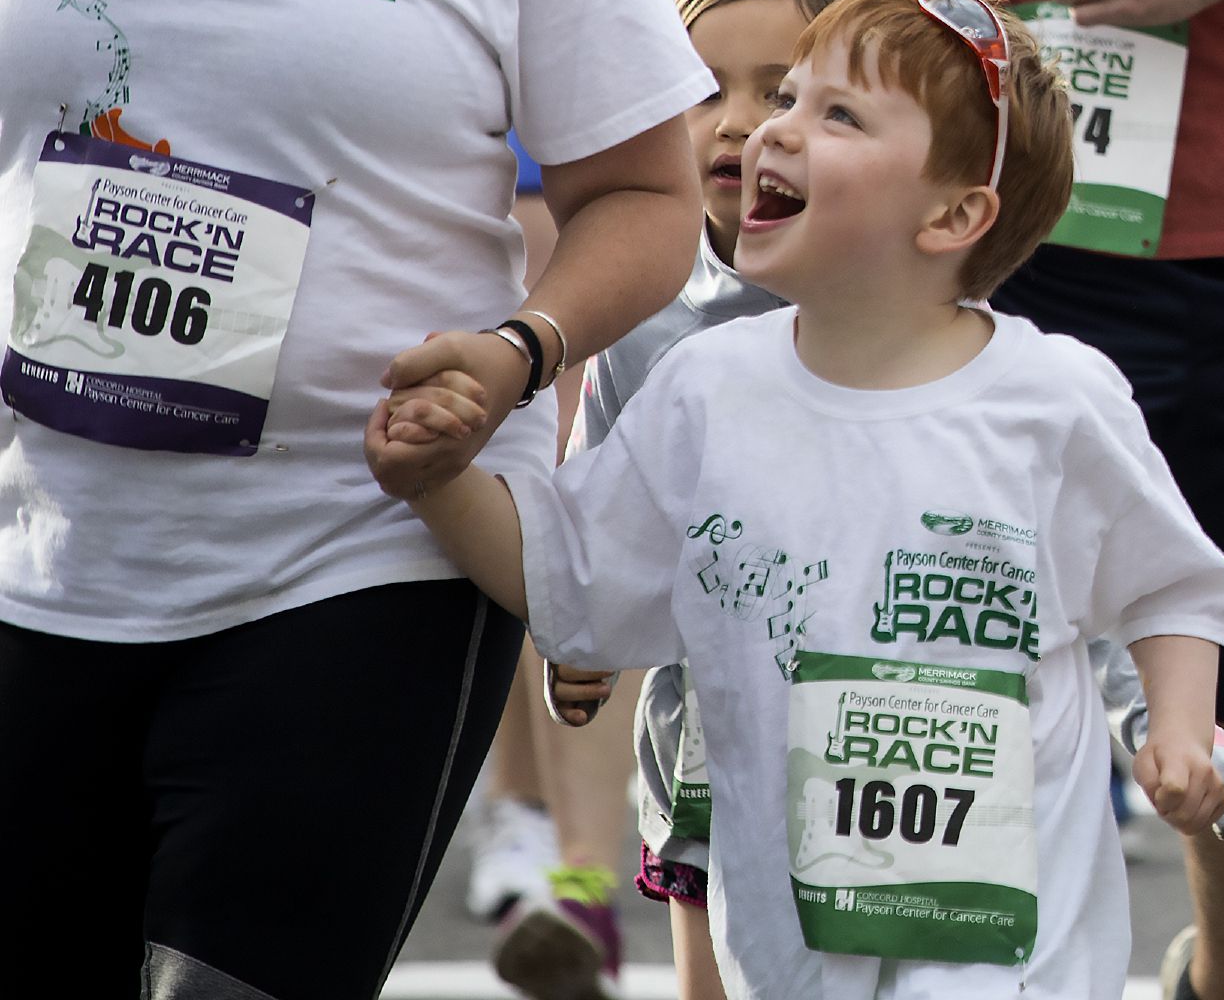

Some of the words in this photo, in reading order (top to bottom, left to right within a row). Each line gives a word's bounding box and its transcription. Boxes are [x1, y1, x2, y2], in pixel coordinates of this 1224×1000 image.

[1040, 45, 1134, 72] OCK'N
[1071, 68, 1131, 99] CE
[173, 162, 231, 185] MERRIMACK
[102, 179, 138, 199] Payson
[139, 187, 171, 207] Center
[172, 196, 188, 210] for
[189, 199, 223, 220] Cancer
[224, 207, 248, 225] Care
[94, 197, 245, 251] ROCK'N
[90, 221, 240, 283] RACE
[73, 262, 212, 345] 4106
[21, 362, 59, 384] BENEFITS
[86, 375, 125, 392] CONCORD
[125, 385, 162, 400] HOSPITAL
[84, 385, 117, 404] Payson
[119, 396, 153, 412] Center
[156, 402, 172, 416] for
[174, 407, 210, 422] Cancer
[214, 415, 240, 426] Care
[896, 549, 937, 570] Payson
[939, 552, 979, 573] Center
[980, 556, 999, 575] for
[1001, 561, 1036, 584] Cance
[893, 573, 1037, 619] ROCK'
[892, 603, 1039, 662] RACE
[918, 667, 977, 681] MERRIMACK
[849, 691, 886, 709] Payson
[888, 695, 923, 711] Center
[924, 698, 939, 713] for
[940, 701, 976, 717] Cancer
[976, 703, 999, 719] Care
[844, 710, 998, 746] ROCK'N
[843, 735, 996, 778] RACE
[680, 788, 711, 799] BENEFI
[835, 778, 976, 847] 1607
[798, 888, 827, 904] BENEFITS
[857, 891, 898, 902] CONCORD
[899, 894, 940, 906] HOSPITAL
[855, 903, 893, 918] Payson
[895, 905, 930, 919] Center
[932, 908, 948, 921] for
[949, 910, 987, 924] Cancer
[990, 914, 1015, 927] Care
